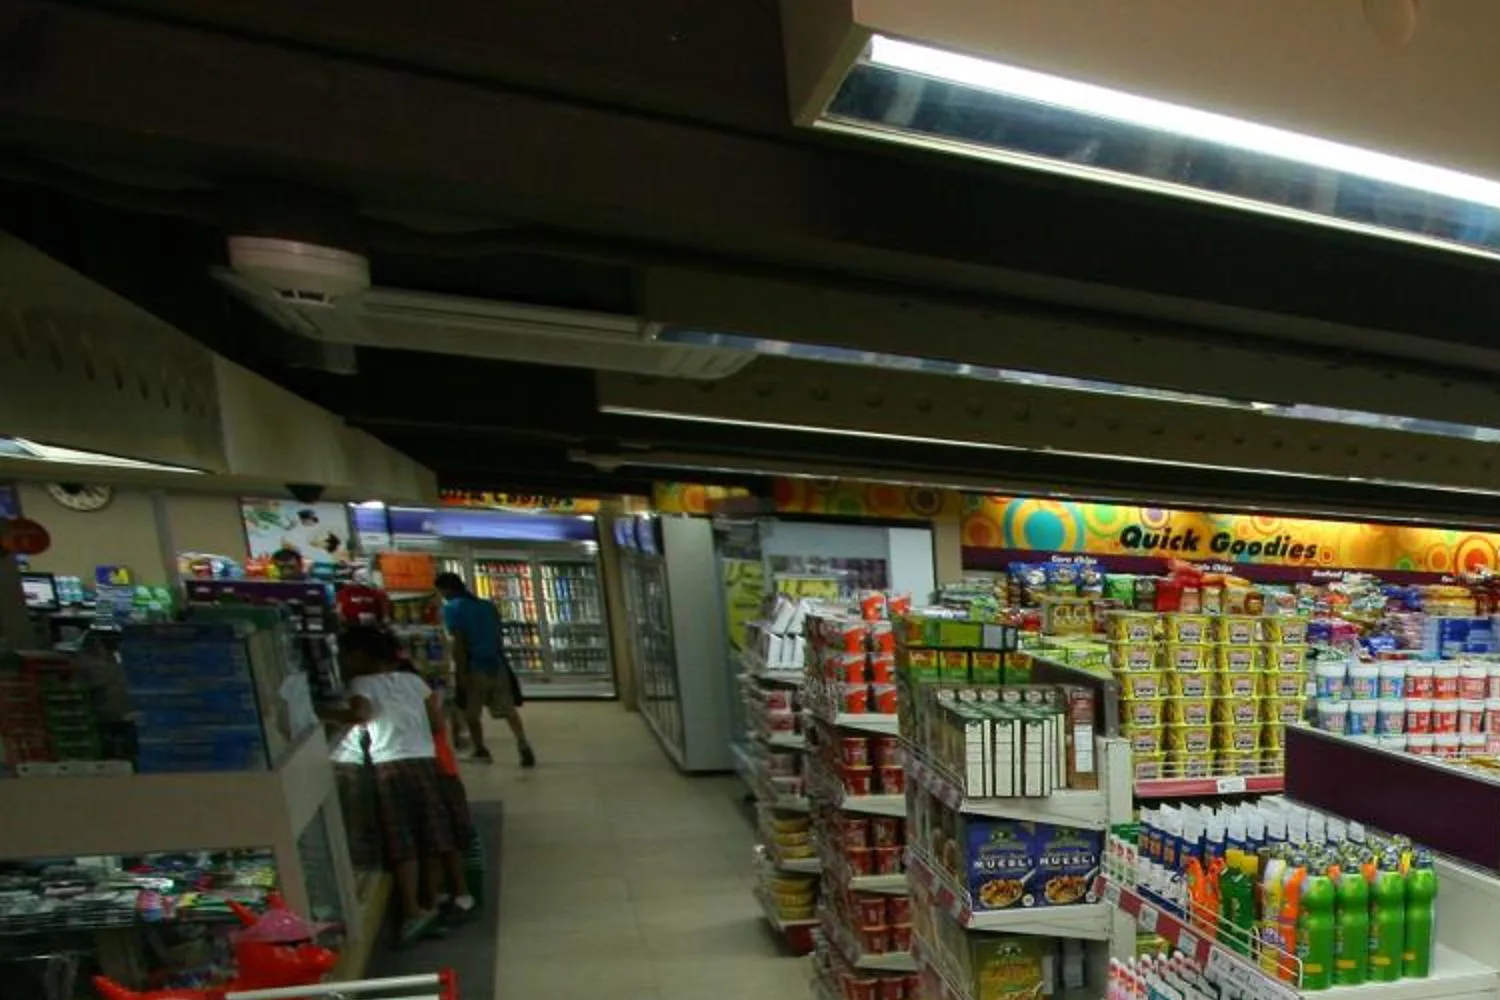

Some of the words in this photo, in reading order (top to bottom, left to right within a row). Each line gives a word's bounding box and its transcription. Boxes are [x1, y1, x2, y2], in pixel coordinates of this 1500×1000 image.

[1120, 523, 1200, 551] Quick
[1210, 531, 1318, 559] Goodies
[1039, 855, 1096, 866] MUESLI
